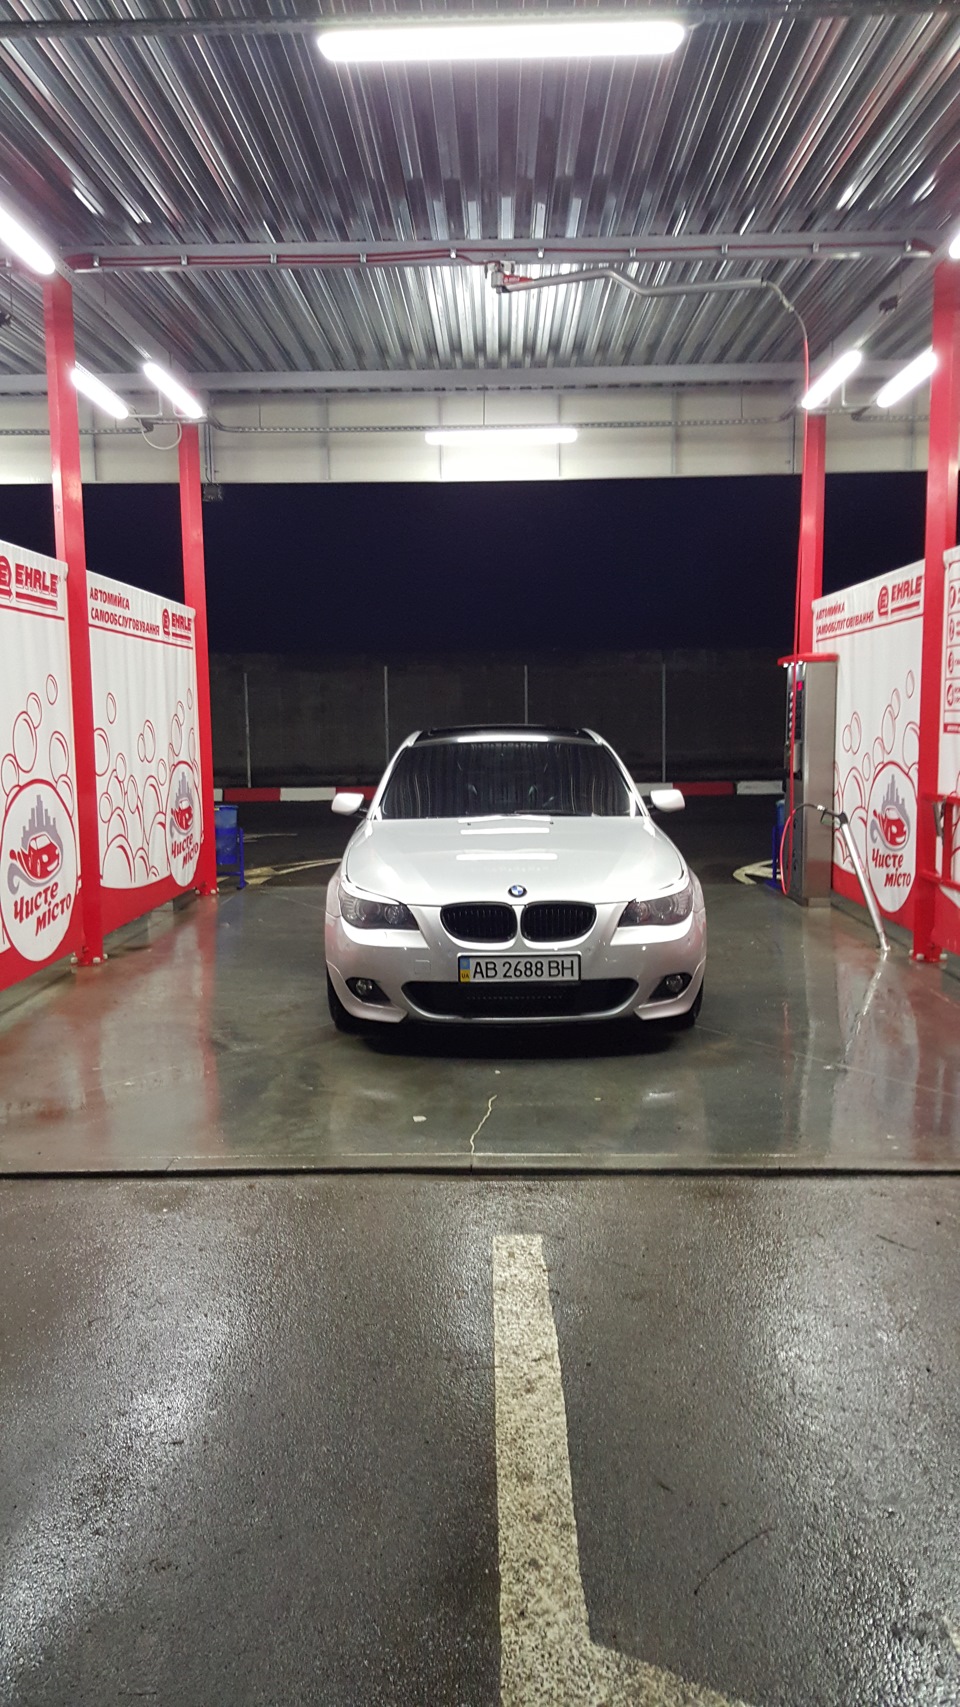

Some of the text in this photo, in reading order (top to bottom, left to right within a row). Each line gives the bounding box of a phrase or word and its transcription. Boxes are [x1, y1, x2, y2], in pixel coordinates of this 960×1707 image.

[15, 563, 59, 595] EHRLE
[891, 576, 923, 601] EHRLE
[90, 587, 130, 610] АВТОМИЙКА
[91, 607, 160, 636] САМООБСЛУГОВУВАННЯ
[171, 612, 192, 631] EHRLE
[871, 848, 903, 868] Чисте
[13, 882, 58, 923] Чисте
[473, 960, 574, 979] AB 2688 BH
